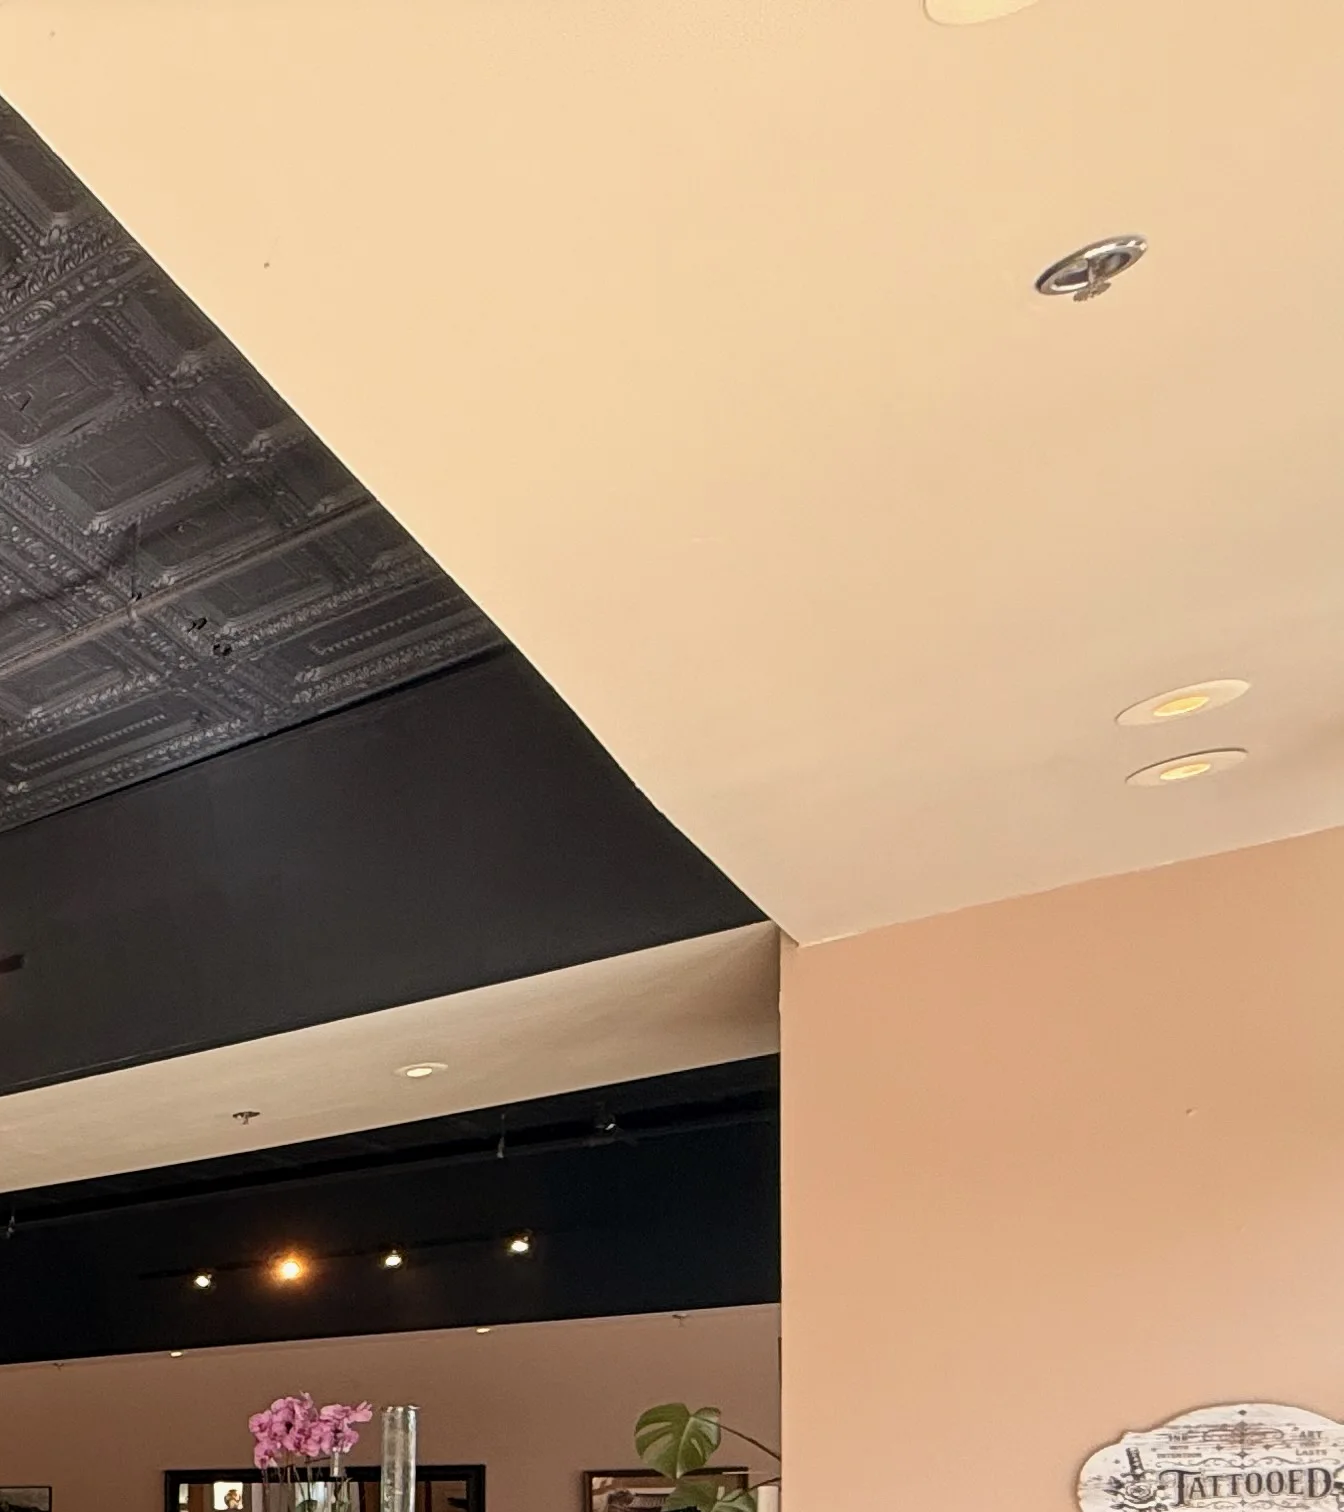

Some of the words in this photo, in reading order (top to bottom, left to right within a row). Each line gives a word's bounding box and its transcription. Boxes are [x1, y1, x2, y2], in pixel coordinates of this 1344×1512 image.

[1299, 1430, 1324, 1439] ART
[1295, 1448, 1328, 1456] LASTS
[1159, 1467, 1332, 1506] TATTOOED
